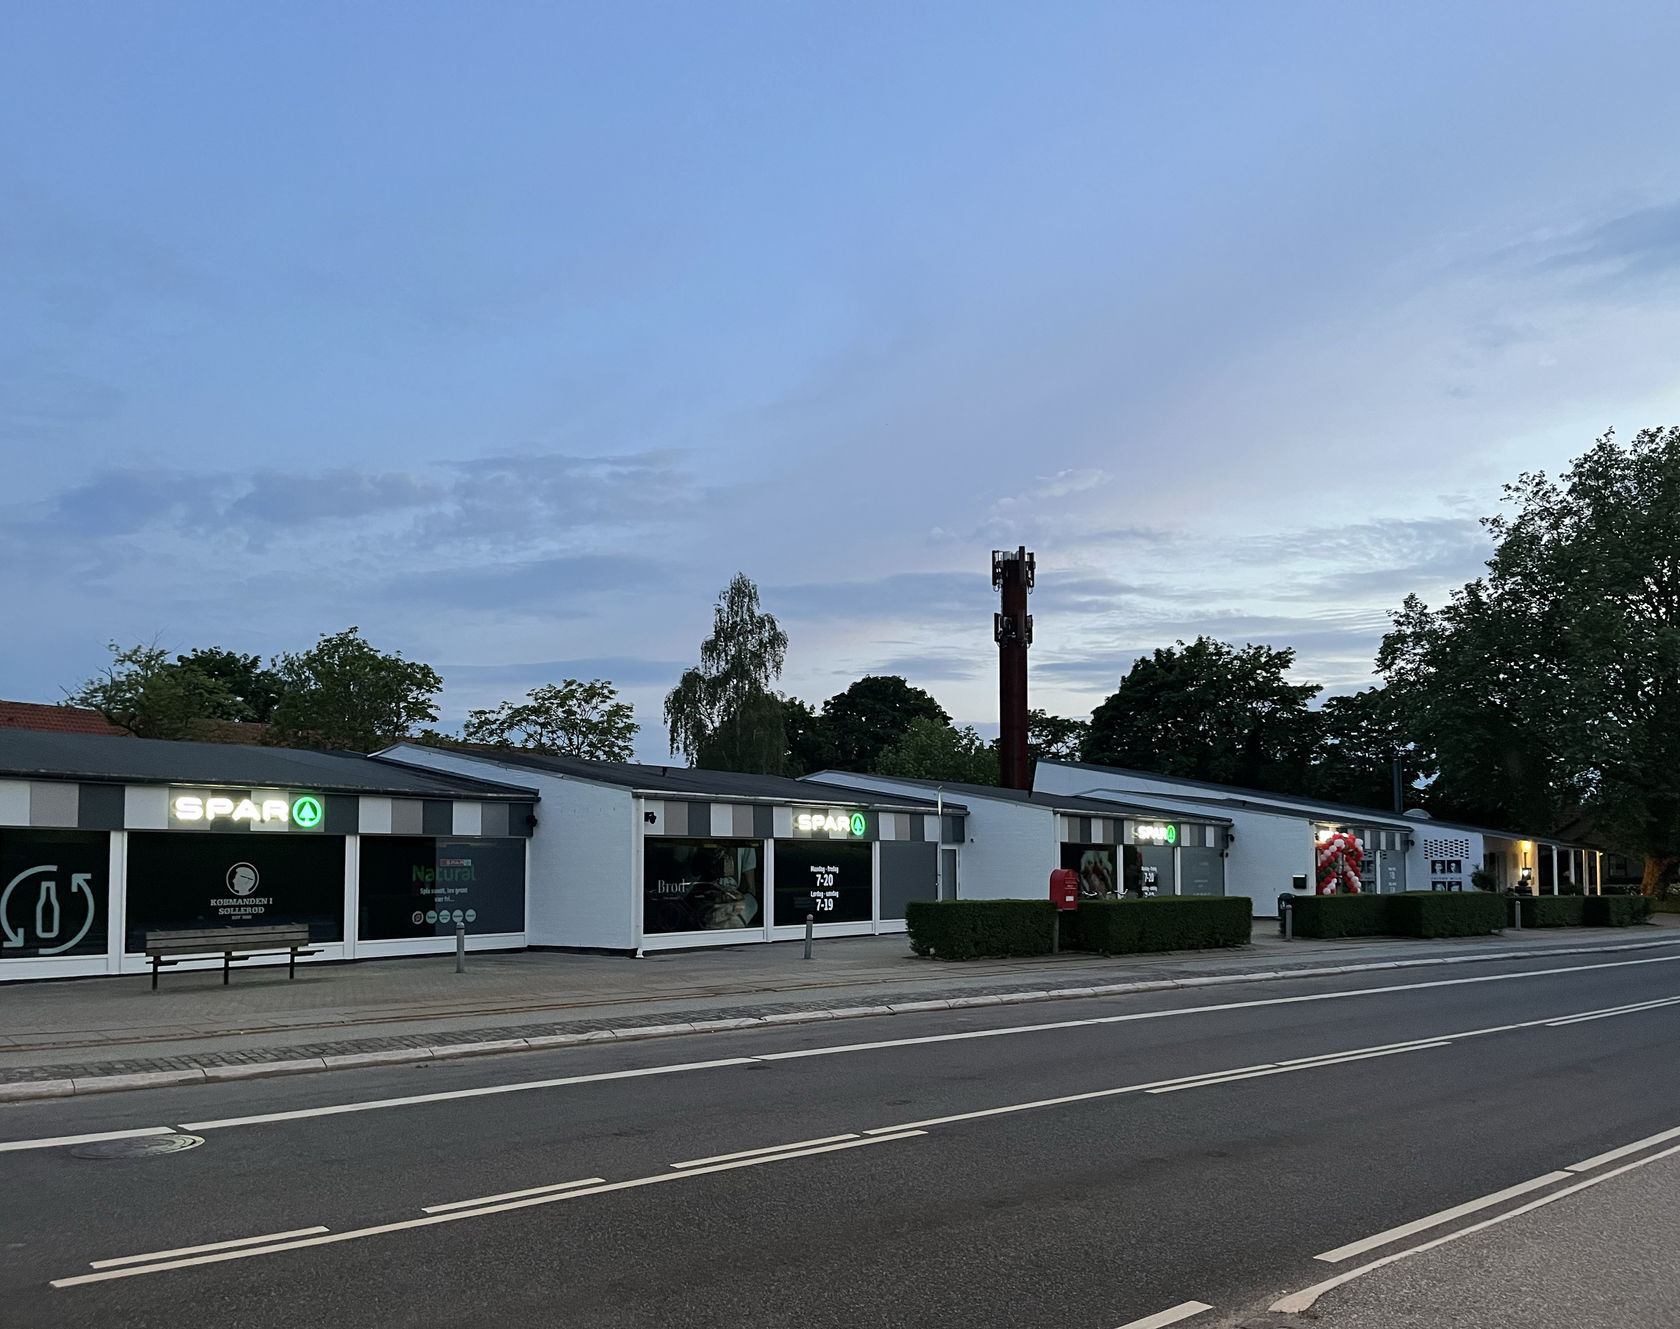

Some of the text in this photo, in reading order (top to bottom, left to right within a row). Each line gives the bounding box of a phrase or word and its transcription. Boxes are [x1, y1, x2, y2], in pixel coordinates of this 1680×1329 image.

[175, 797, 289, 822] SPAR
[798, 814, 850, 832] SPAR
[412, 864, 477, 882] Natural
[815, 874, 834, 887] 7-20
[815, 898, 834, 911] 7-19
